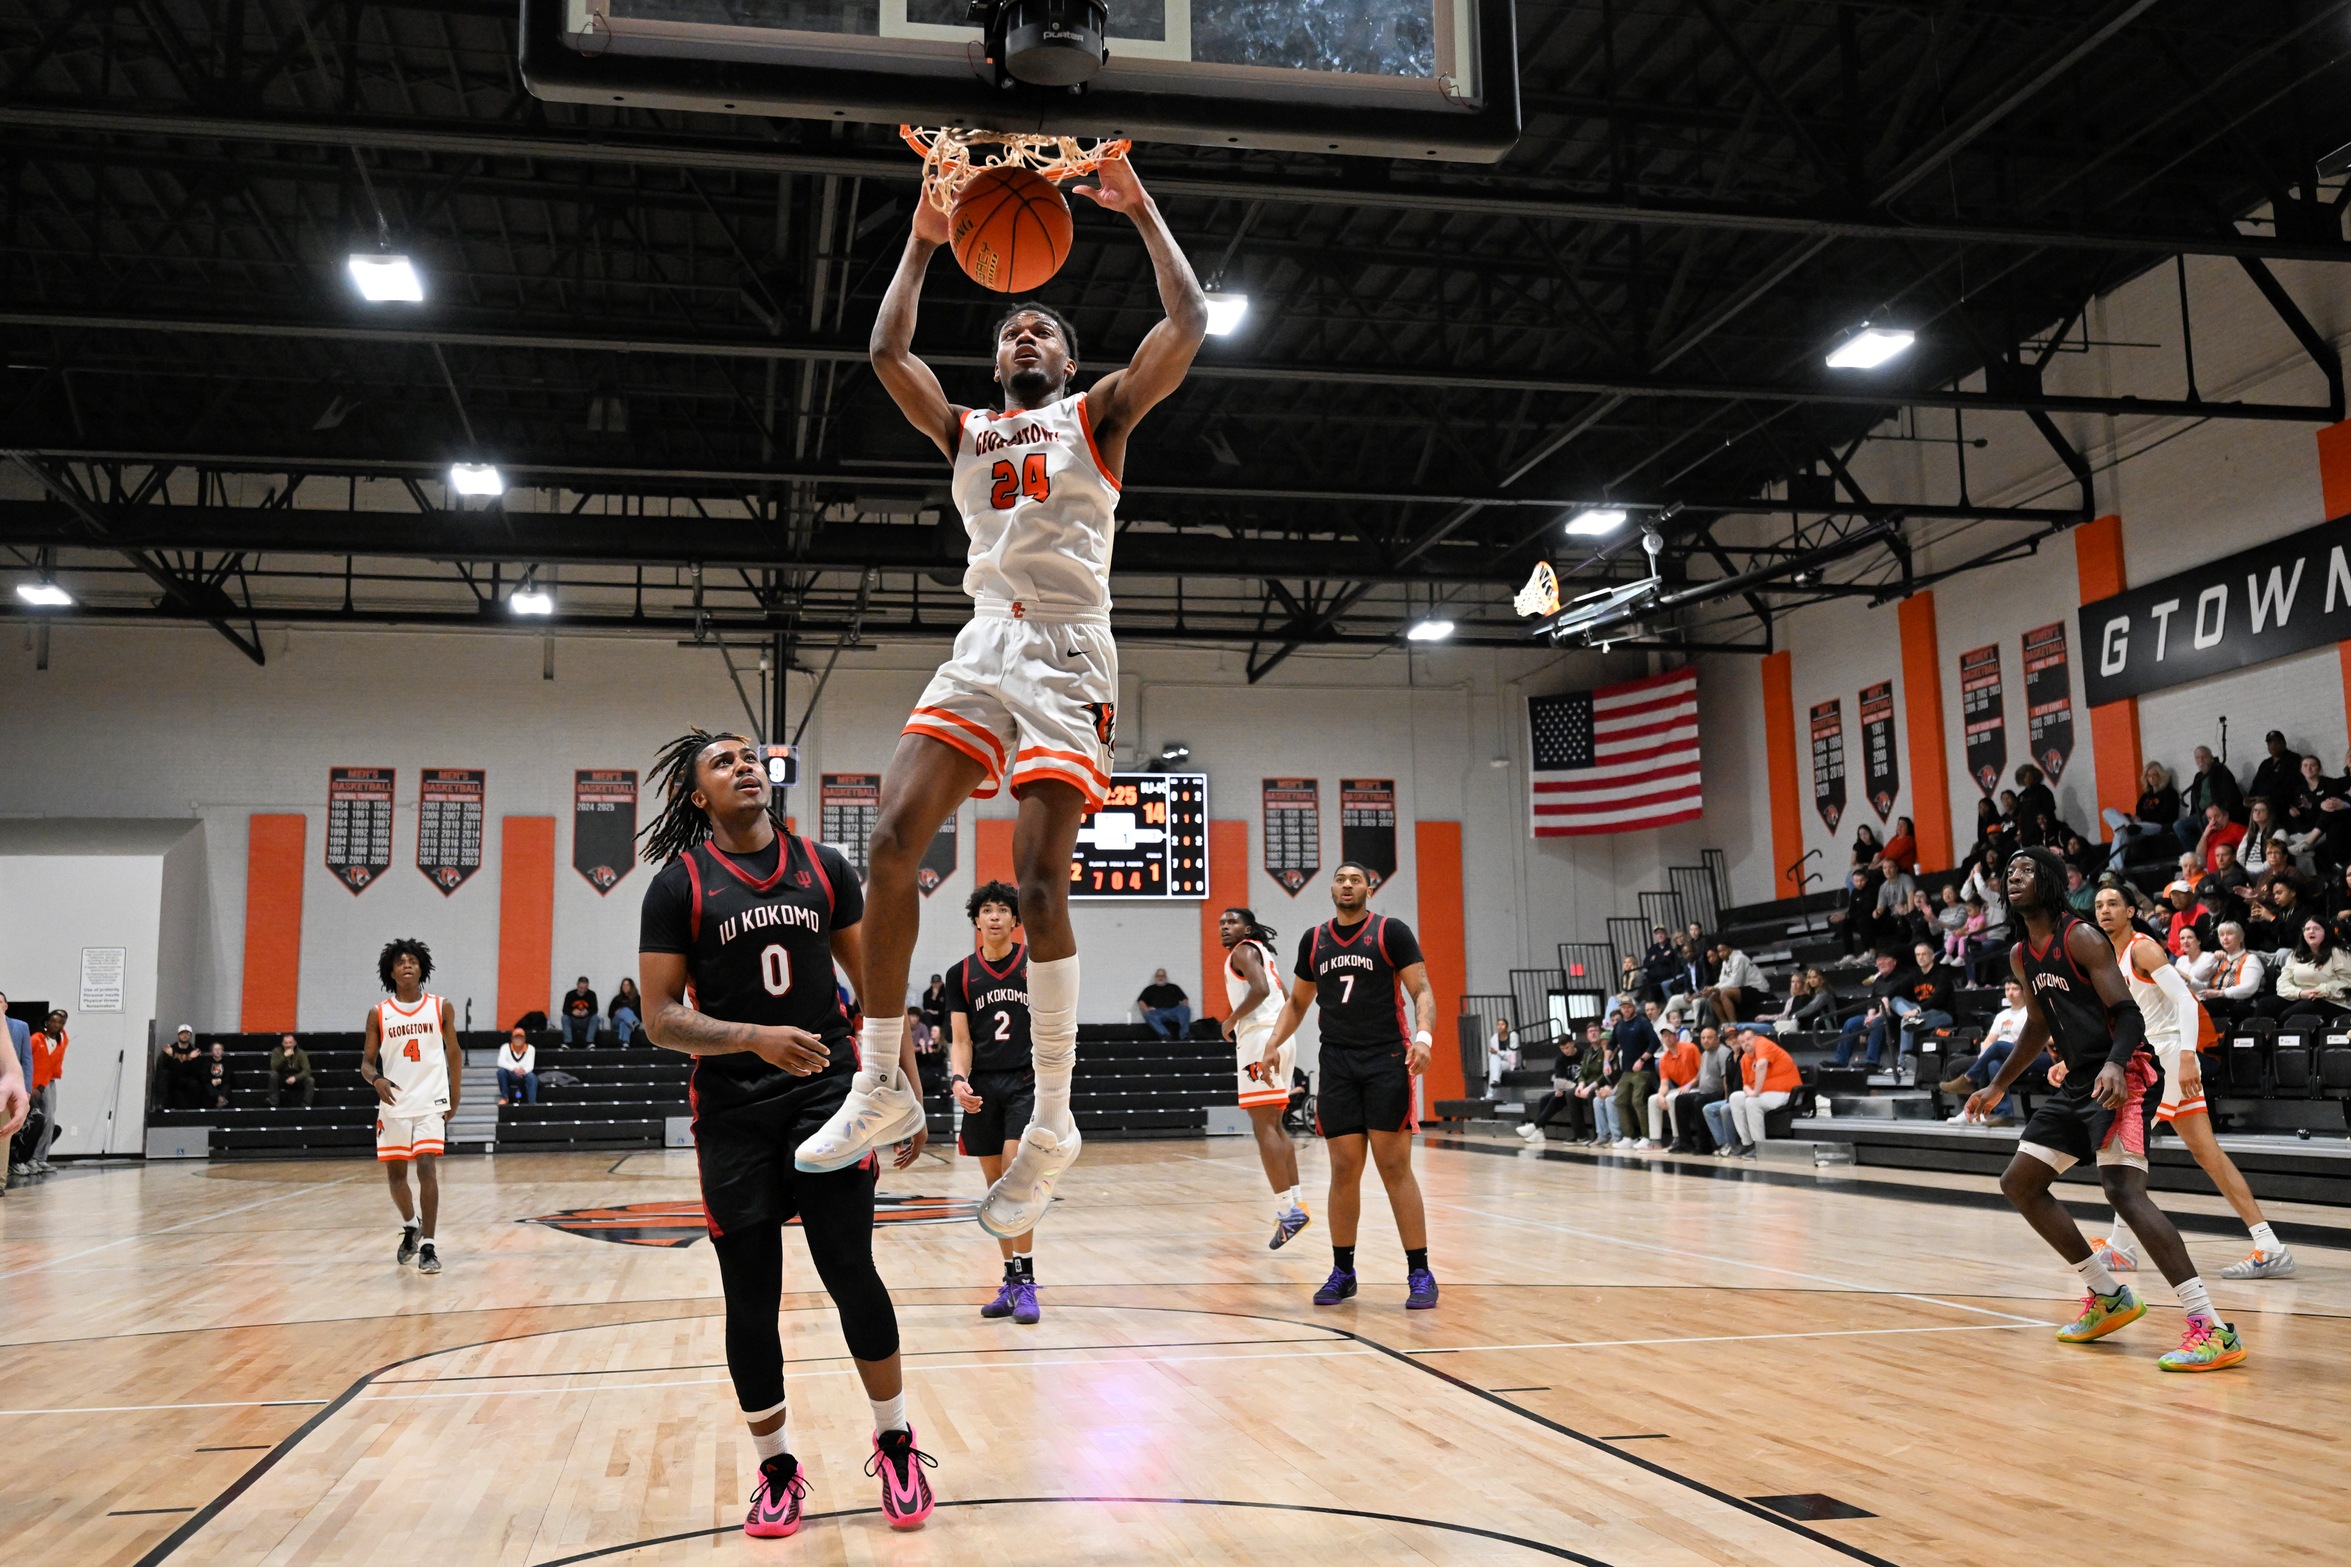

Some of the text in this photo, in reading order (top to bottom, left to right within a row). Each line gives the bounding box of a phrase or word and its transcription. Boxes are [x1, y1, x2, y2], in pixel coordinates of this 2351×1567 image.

[976, 241, 990, 285] EGACY
[990, 453, 1050, 510] 24
[2027, 672, 2038, 685] 2012
[2044, 713, 2056, 726] 2001
[2032, 728, 2043, 741] 2012
[348, 770, 378, 779] MEN'S
[439, 771, 468, 780] MEN'S
[332, 782, 392, 791] BASKETBALL
[424, 784, 482, 792] BASKETBALL
[578, 785, 635, 793] BASKETBALL
[823, 788, 879, 797] BASKETBALL
[1194, 791, 1202, 801] 2
[332, 801, 348, 809] 1954
[353, 801, 369, 809] 1955
[422, 803, 481, 811] 2003 2004 2005
[577, 803, 615, 811] 2024 2025
[352, 810, 369, 819] 1961
[373, 810, 390, 819] 1962
[443, 812, 460, 820] 2007
[1142, 802, 1166, 824] 14
[331, 819, 347, 828] 1964
[1184, 814, 1189, 824] 1
[421, 821, 480, 829] 2009 2010 2011
[862, 824, 874, 832] 197
[352, 829, 368, 837] 1992
[421, 830, 480, 839] 2012 2013 2014
[330, 838, 346, 846] 1994
[351, 838, 368, 846] 1995
[420, 839, 479, 848] 2015 2016 2017
[1171, 836, 1178, 846] 2
[1195, 836, 1202, 846] 2
[329, 847, 346, 856] 1997
[420, 849, 479, 857] 2018 2019 2020
[328, 856, 388, 864] 2000 2001 2002
[419, 857, 478, 866] 2021 2022 2023
[1195, 858, 1203, 868] 4
[1071, 862, 1082, 882] 2
[1149, 862, 1159, 882] 1
[1093, 870, 1142, 890] 7 0 4
[719, 904, 819, 946] IU KOKOMO
[1320, 955, 1374, 976] IU KOKOMO
[761, 943, 792, 998] 0
[1339, 975, 1354, 1003] 7
[975, 989, 1028, 1012] IU KOKOMO
[994, 1010, 1010, 1040] 2
[388, 1023, 434, 1038] GEORGETOWN
[403, 1039, 420, 1062] 4
